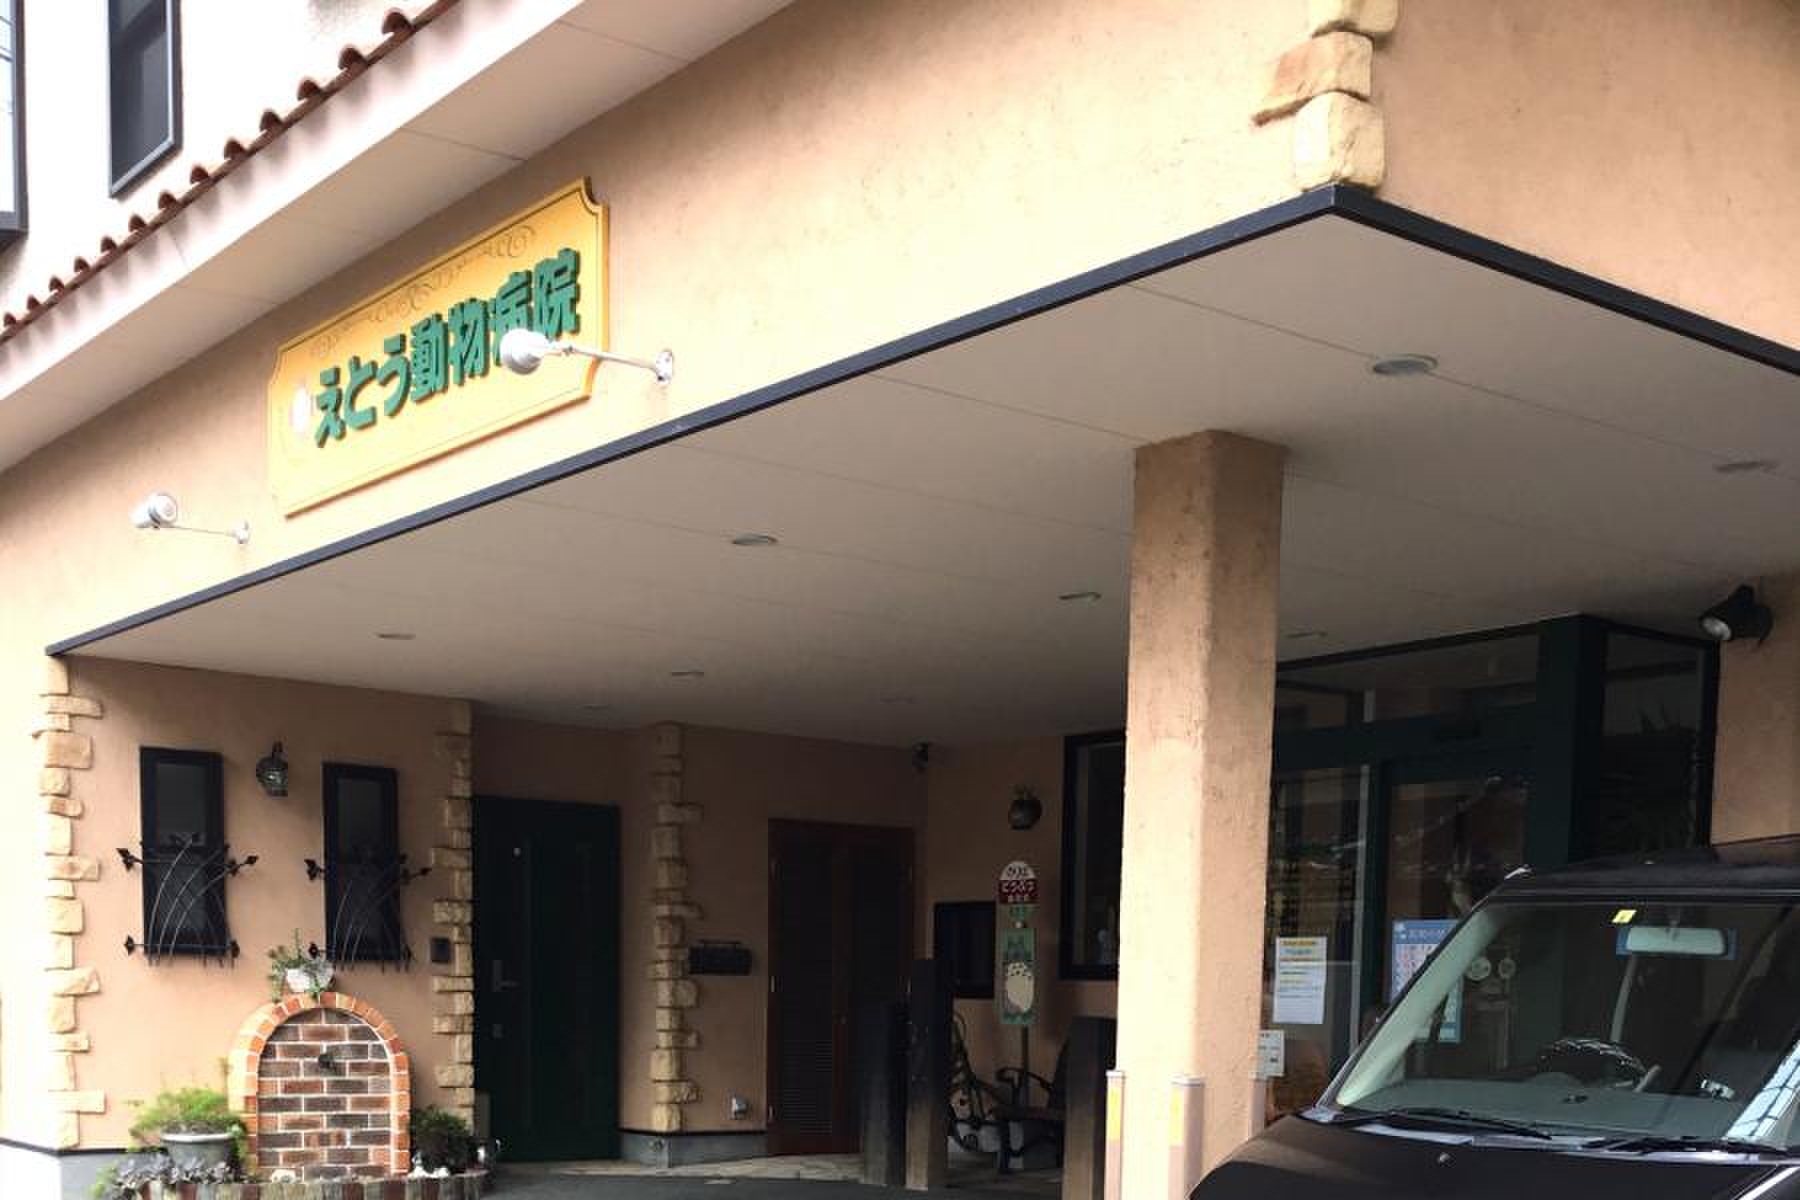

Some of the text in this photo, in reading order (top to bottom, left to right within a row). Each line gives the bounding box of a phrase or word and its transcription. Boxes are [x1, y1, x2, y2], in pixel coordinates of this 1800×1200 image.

[315, 248, 580, 448] えとう動物病院
